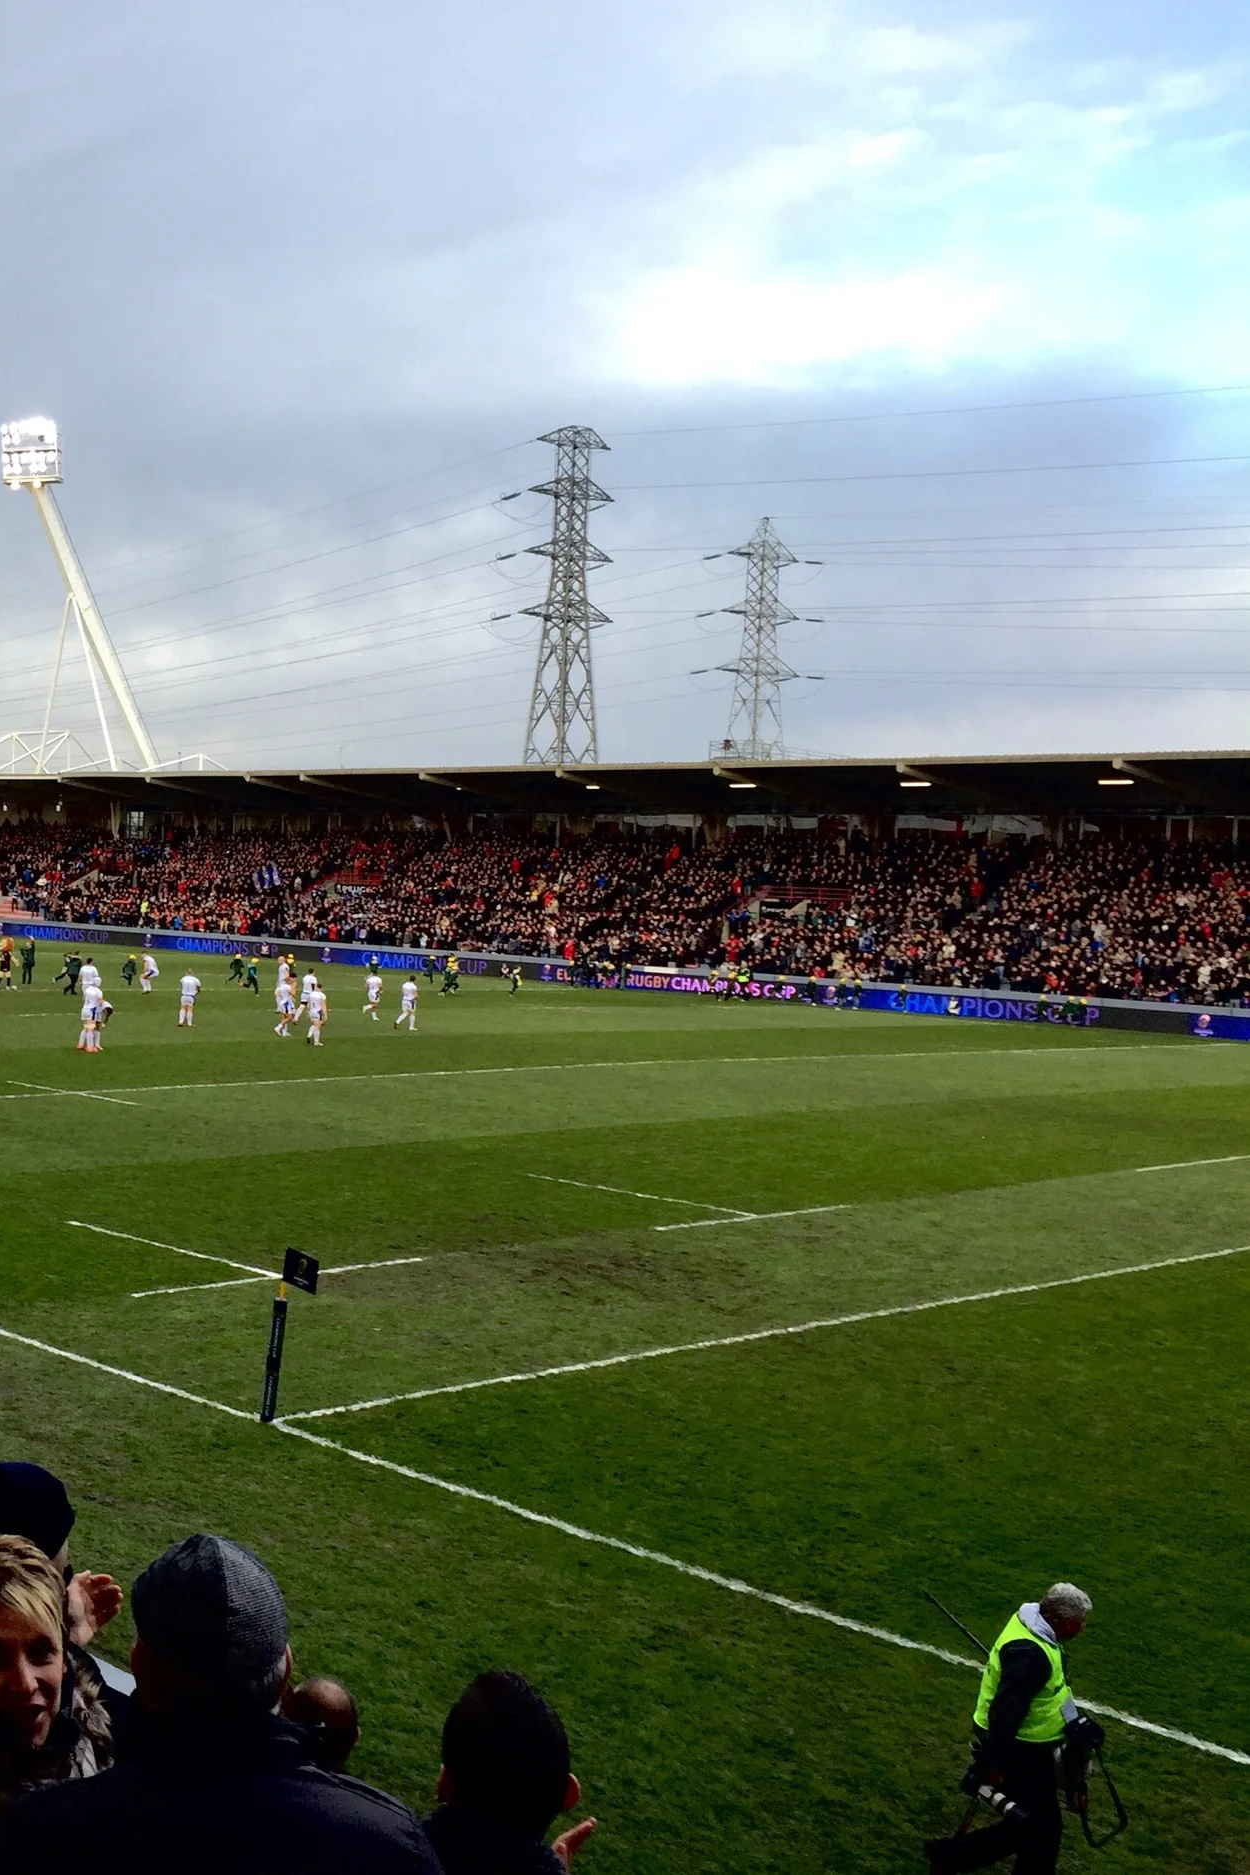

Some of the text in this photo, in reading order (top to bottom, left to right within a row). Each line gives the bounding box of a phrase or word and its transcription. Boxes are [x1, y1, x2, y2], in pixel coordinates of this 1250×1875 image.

[24, 925, 109, 943] CHAMPIONS CUP
[176, 937, 278, 957] CHAMPIONS CP
[627, 973, 670, 988] RUGBY
